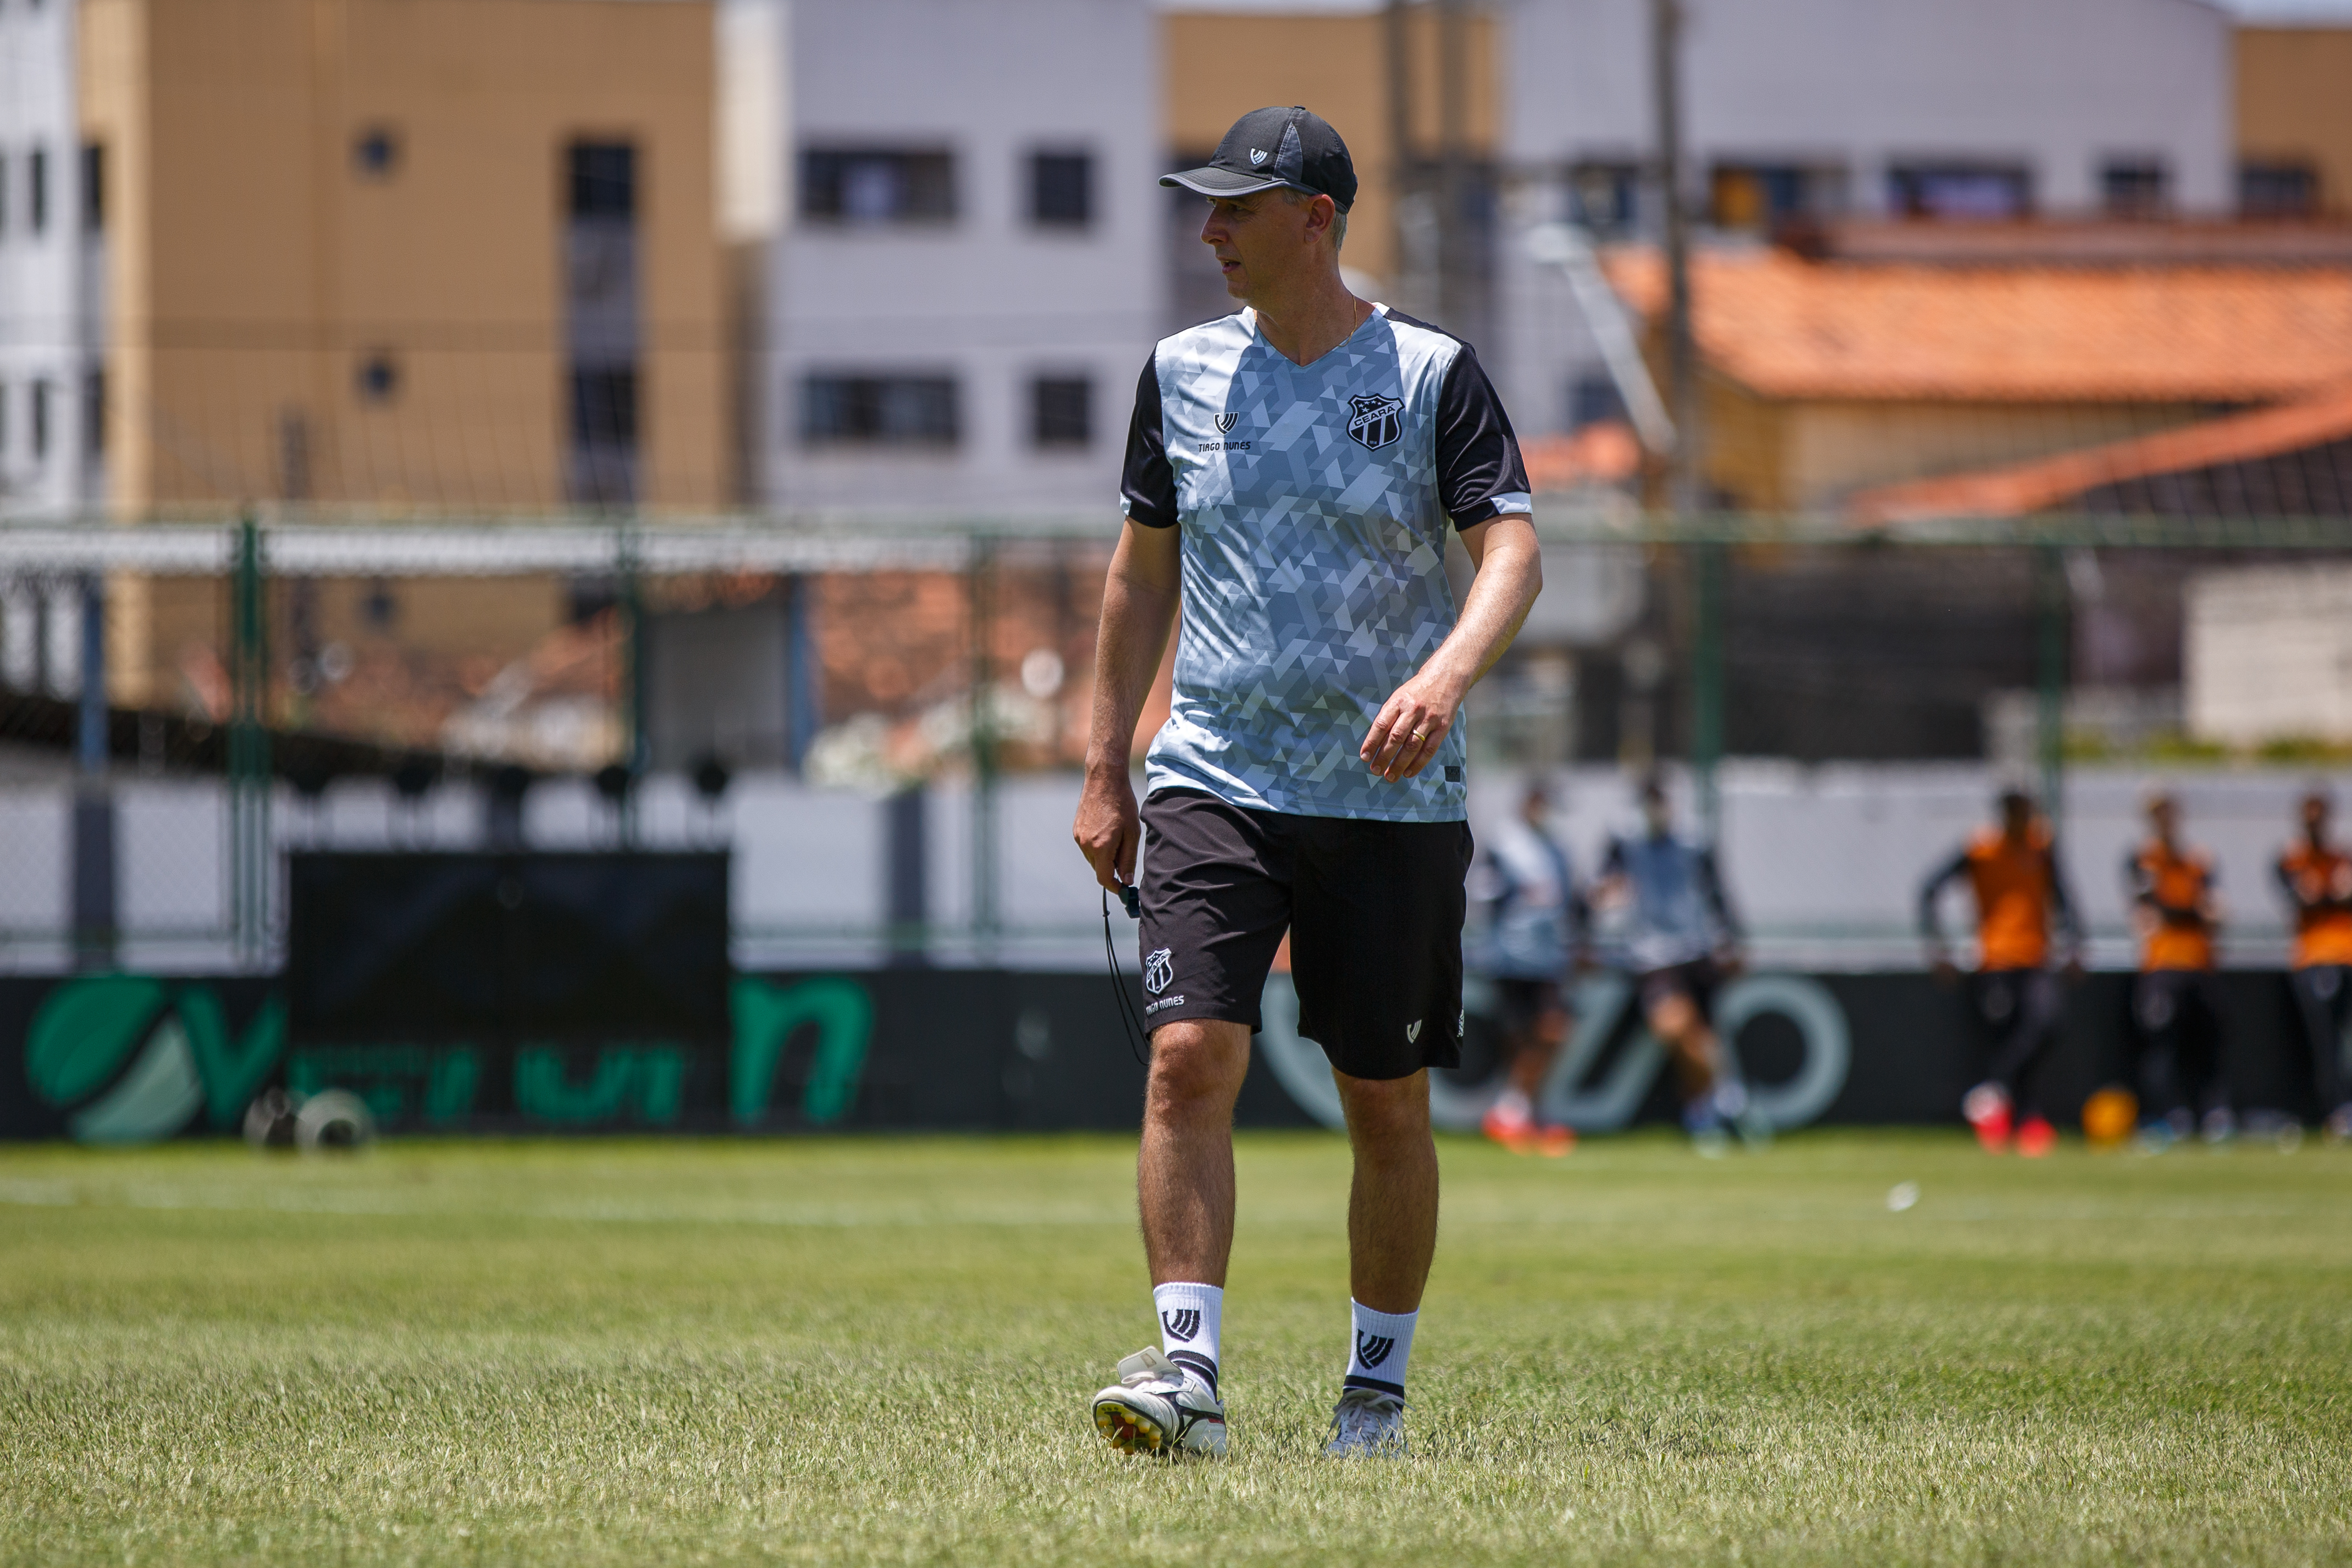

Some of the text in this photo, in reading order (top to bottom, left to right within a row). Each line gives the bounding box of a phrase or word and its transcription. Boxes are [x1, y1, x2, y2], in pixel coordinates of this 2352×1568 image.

[1354, 404, 1396, 427] CEARÁ
[1199, 441, 1251, 452] TIAGO NUNES
[1160, 995, 1184, 1010] NUNES
